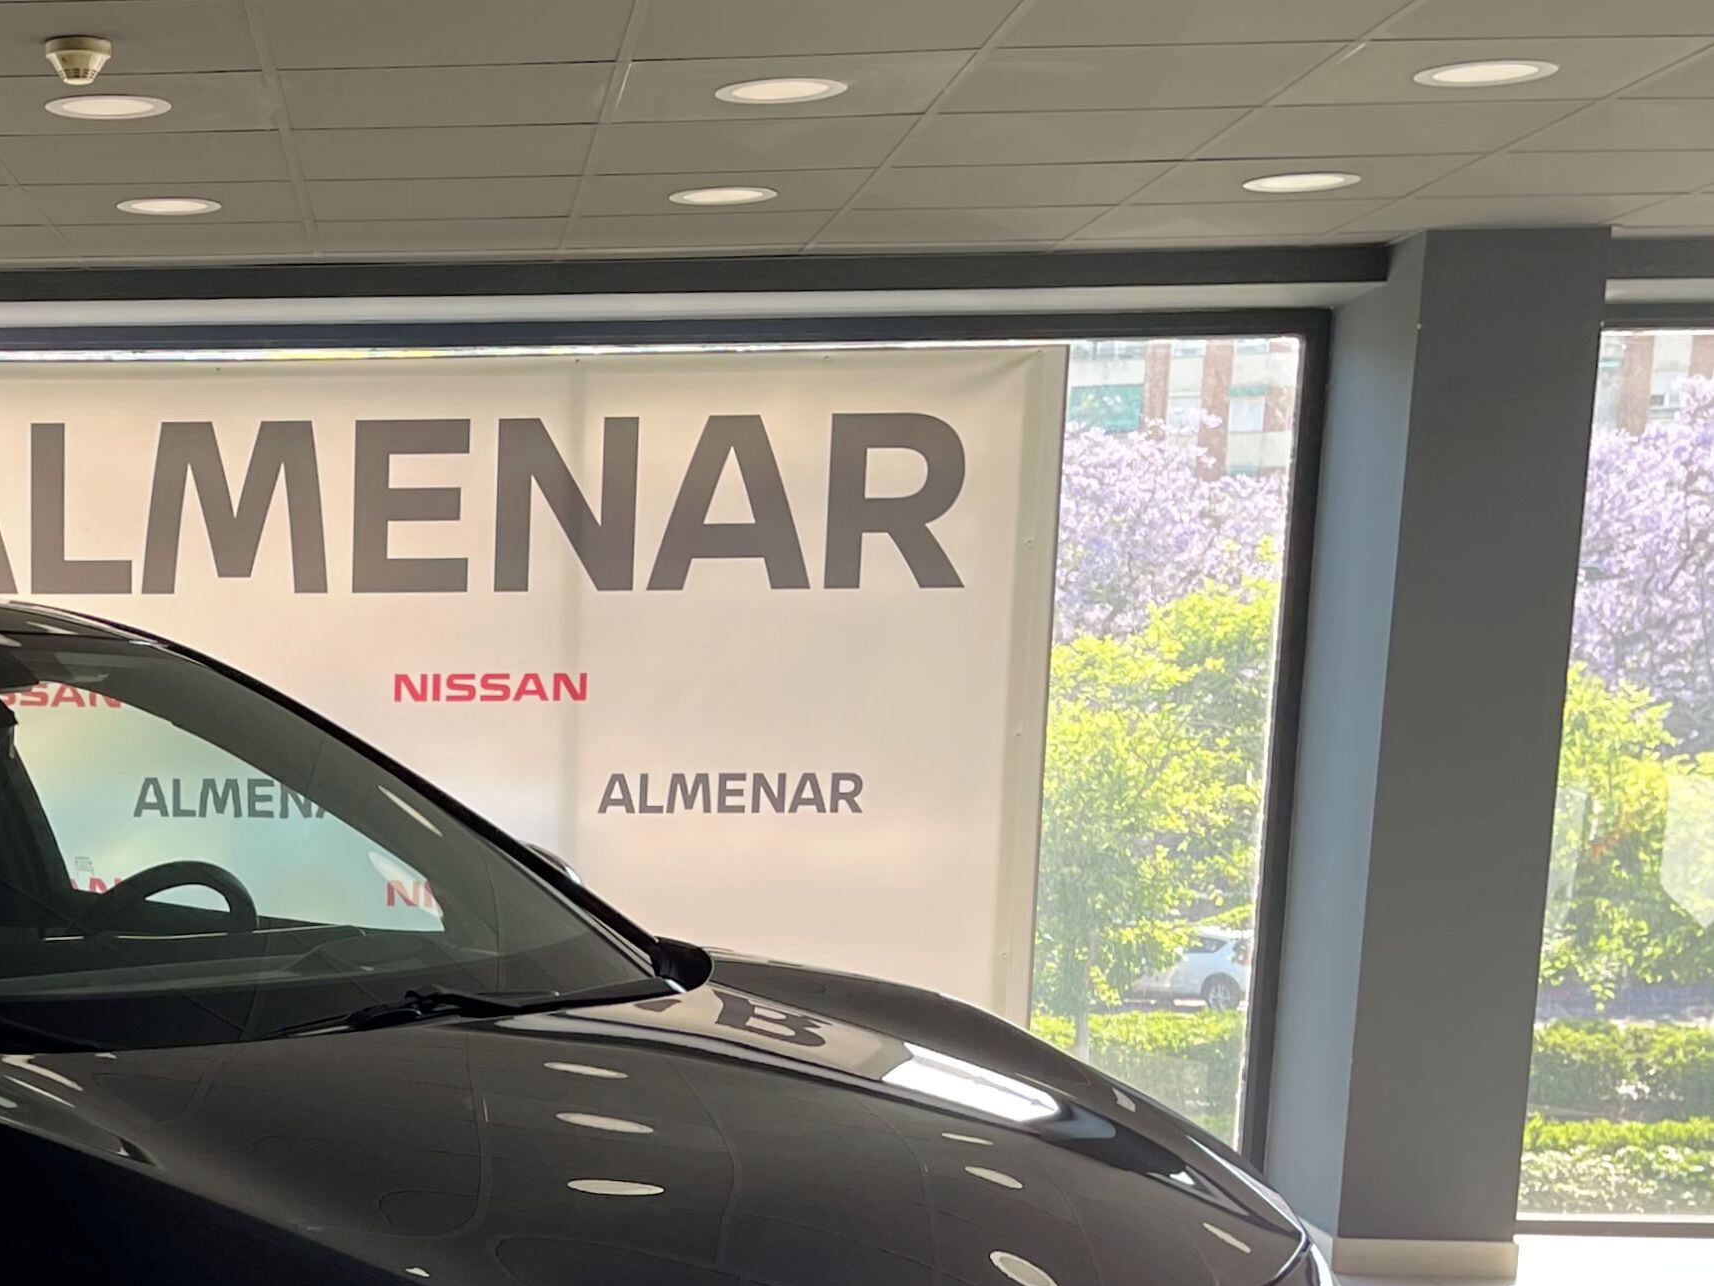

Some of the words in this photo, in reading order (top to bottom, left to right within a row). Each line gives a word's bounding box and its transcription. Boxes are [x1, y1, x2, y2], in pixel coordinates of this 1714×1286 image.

[393, 671, 589, 703] NISSAN
[133, 777, 327, 819] ALMEN
[597, 772, 864, 815] ALMENAR
